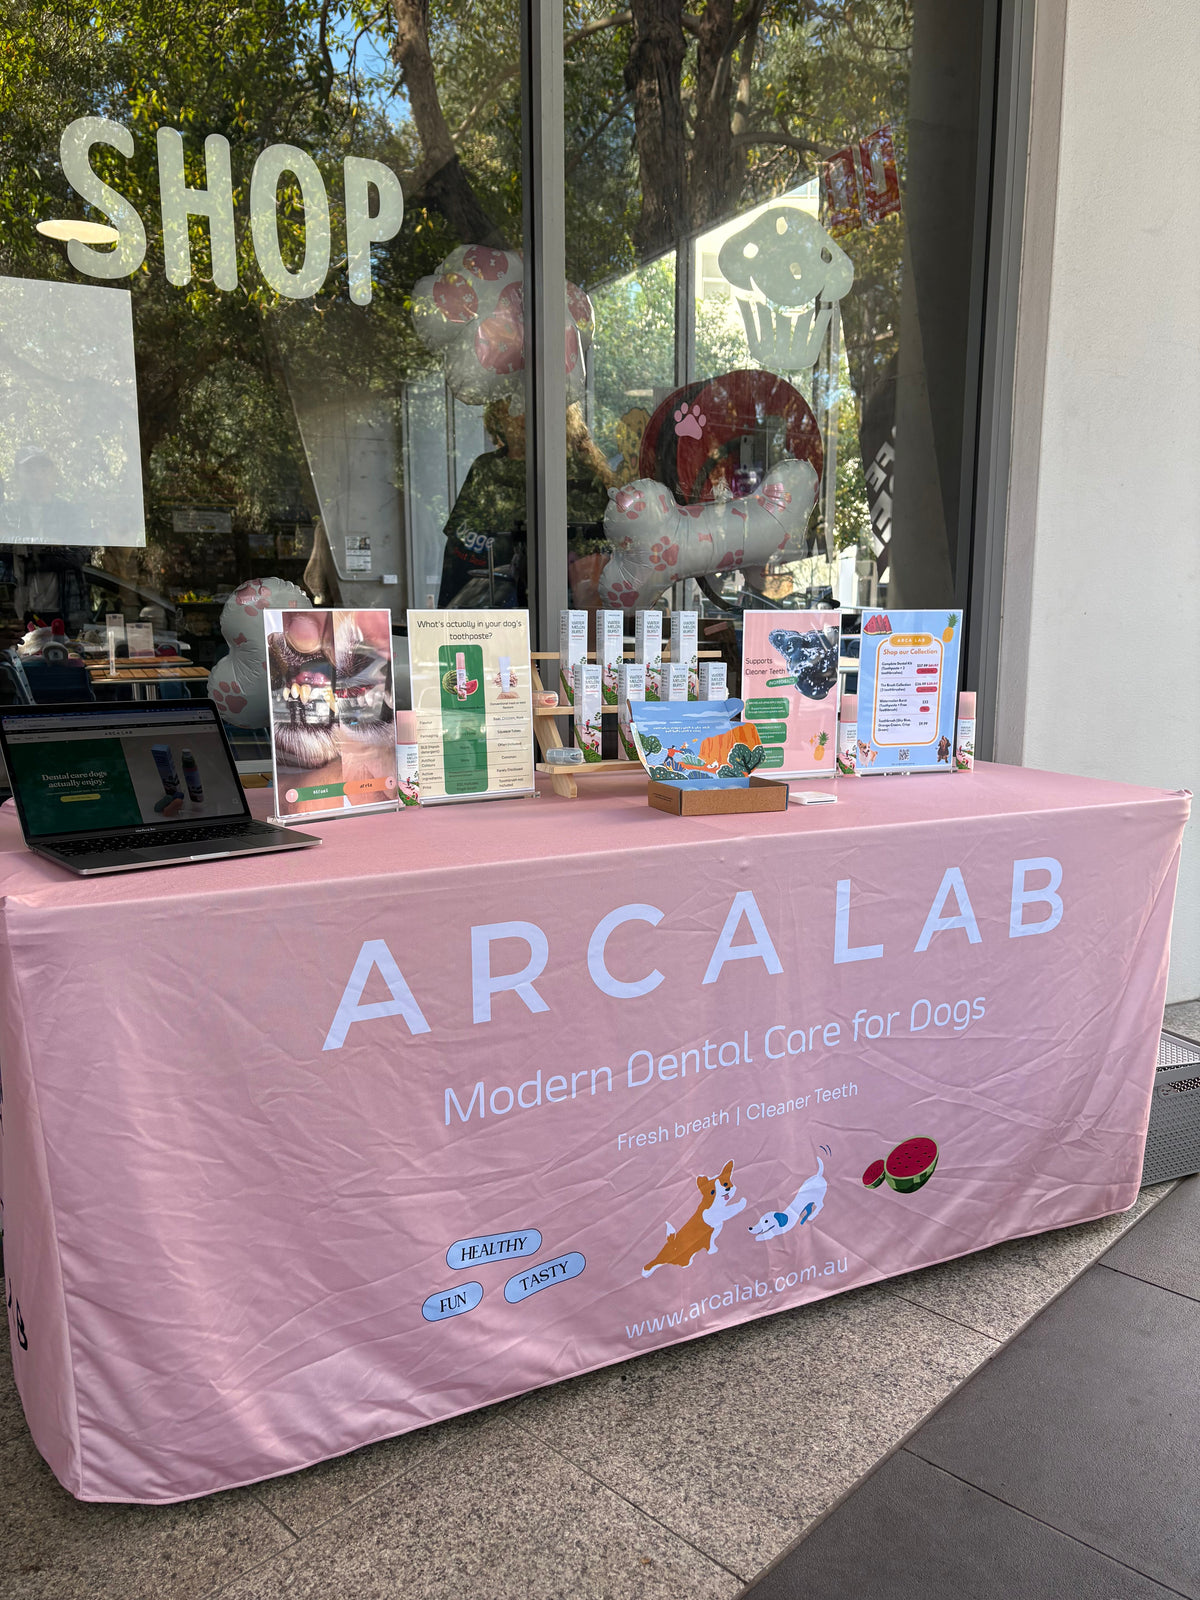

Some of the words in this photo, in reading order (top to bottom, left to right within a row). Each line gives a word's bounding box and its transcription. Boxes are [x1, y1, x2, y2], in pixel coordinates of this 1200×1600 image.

[60, 116, 404, 306] SHOP
[446, 620, 476, 629] actually
[503, 620, 522, 629] dog's
[449, 632, 493, 640] toothpaste?
[41, 773, 70, 781] Dental
[48, 779, 81, 788] actually
[322, 889, 784, 1051] ARCA
[834, 856, 1064, 964] LAB
[444, 1065, 612, 1126] Modern
[627, 1031, 753, 1088] Dental
[764, 1021, 841, 1060] Care
[852, 1009, 900, 1042] for
[910, 996, 986, 1031] Dogs
[618, 1127, 669, 1151] Fresh
[675, 1108, 730, 1139] breath
[746, 1095, 810, 1121] Cleaner
[814, 1082, 858, 1105] Teeth
[460, 1236, 529, 1262] HEALTHY
[519, 1261, 569, 1292] TASTY
[440, 1292, 468, 1314] FUN
[625, 1257, 849, 1340] www.arcalab.com.au
